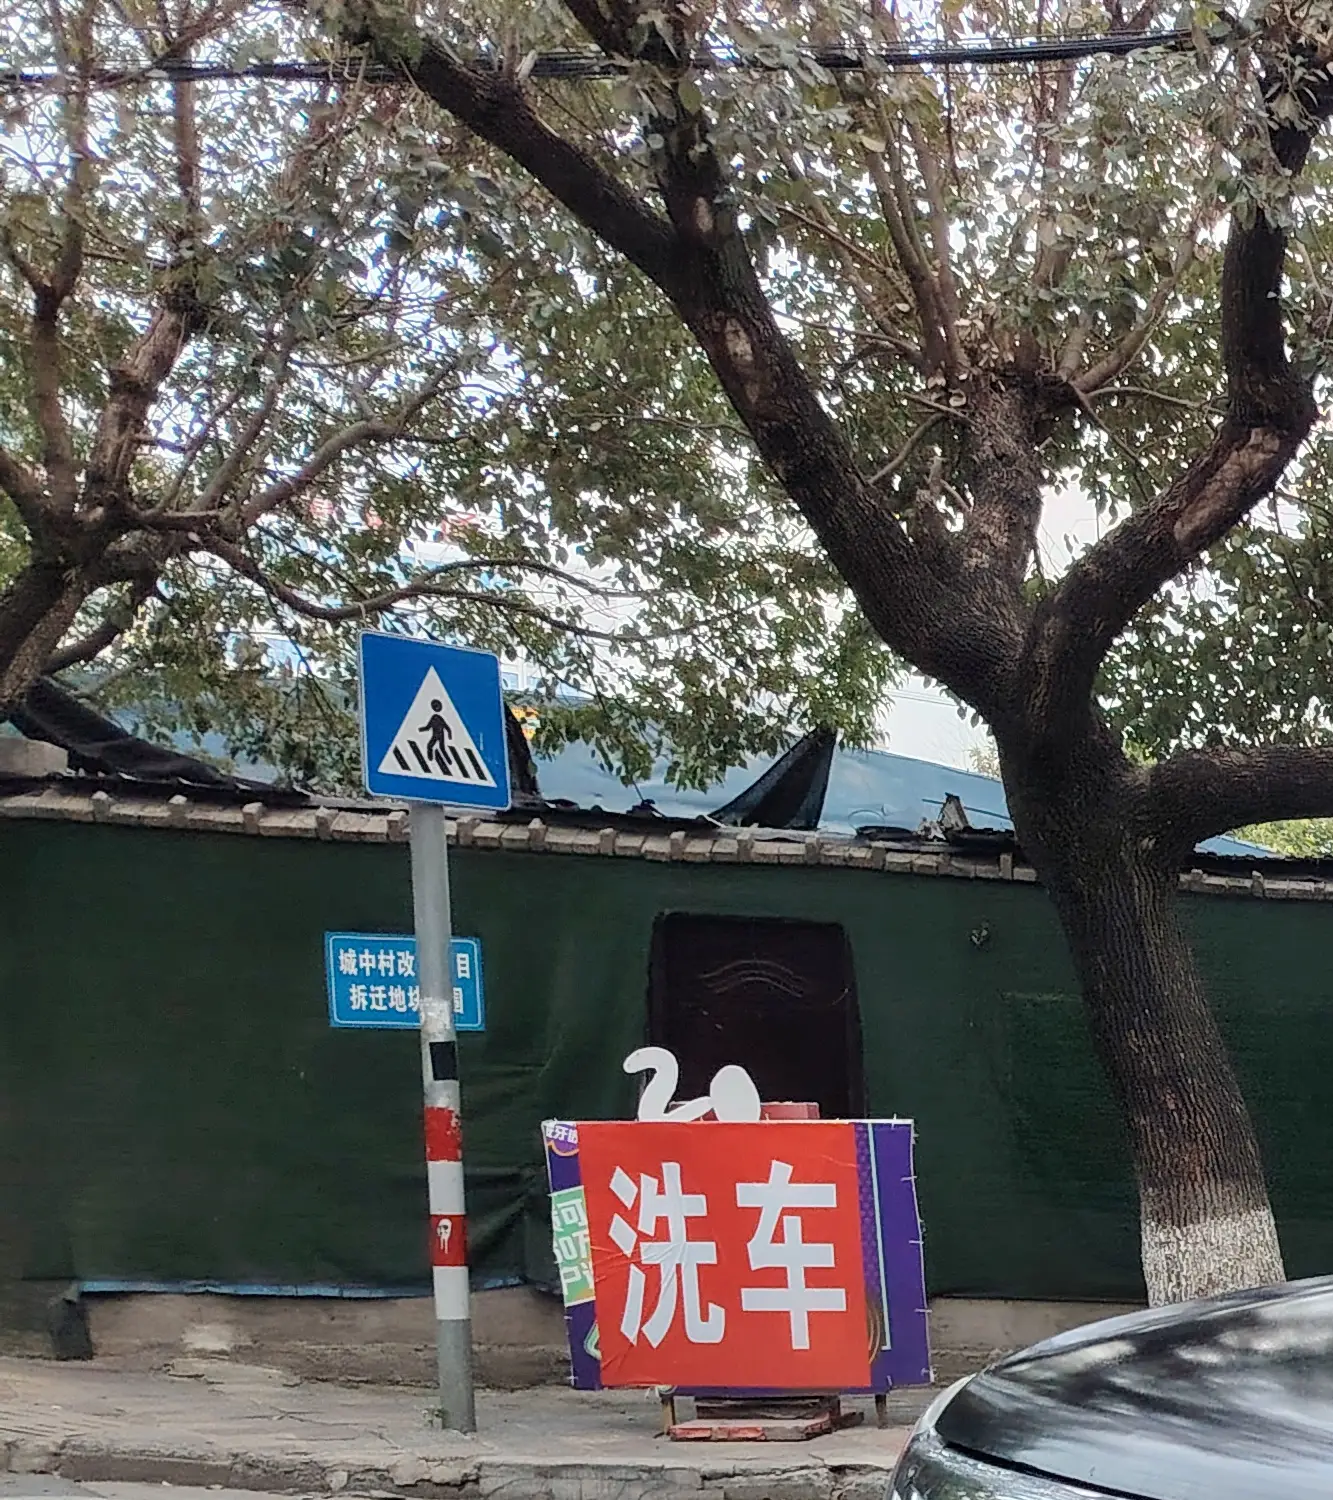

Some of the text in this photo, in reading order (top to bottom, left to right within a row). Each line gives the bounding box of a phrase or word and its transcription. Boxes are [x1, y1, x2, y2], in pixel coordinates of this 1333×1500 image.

[338, 948, 471, 979] 城中村改目
[608, 1159, 847, 1350] 洗车
